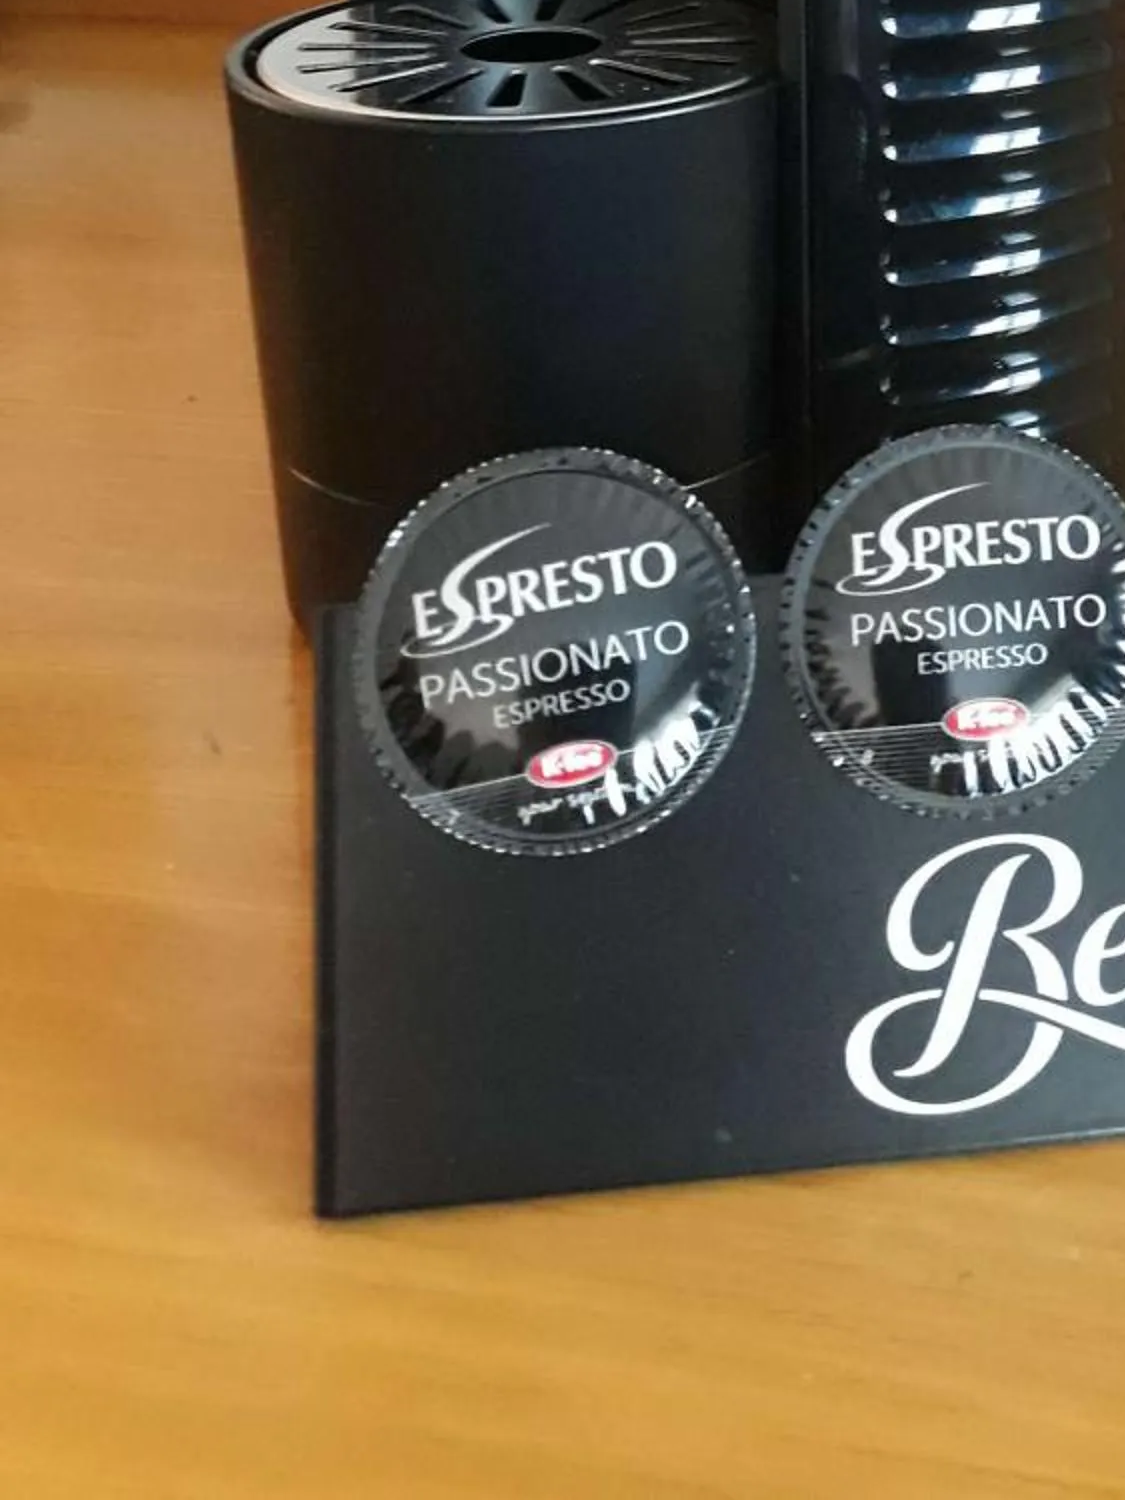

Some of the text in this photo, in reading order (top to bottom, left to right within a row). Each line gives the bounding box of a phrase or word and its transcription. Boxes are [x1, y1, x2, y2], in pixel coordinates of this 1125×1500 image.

[835, 481, 1100, 597] ESPRESTO
[401, 522, 677, 659] ESPRESTO
[850, 593, 1106, 647] PASSIONATO
[419, 620, 690, 709] PASSIONATO
[917, 643, 1048, 675] ESPRESSO
[492, 678, 631, 729] ESPRESSO
